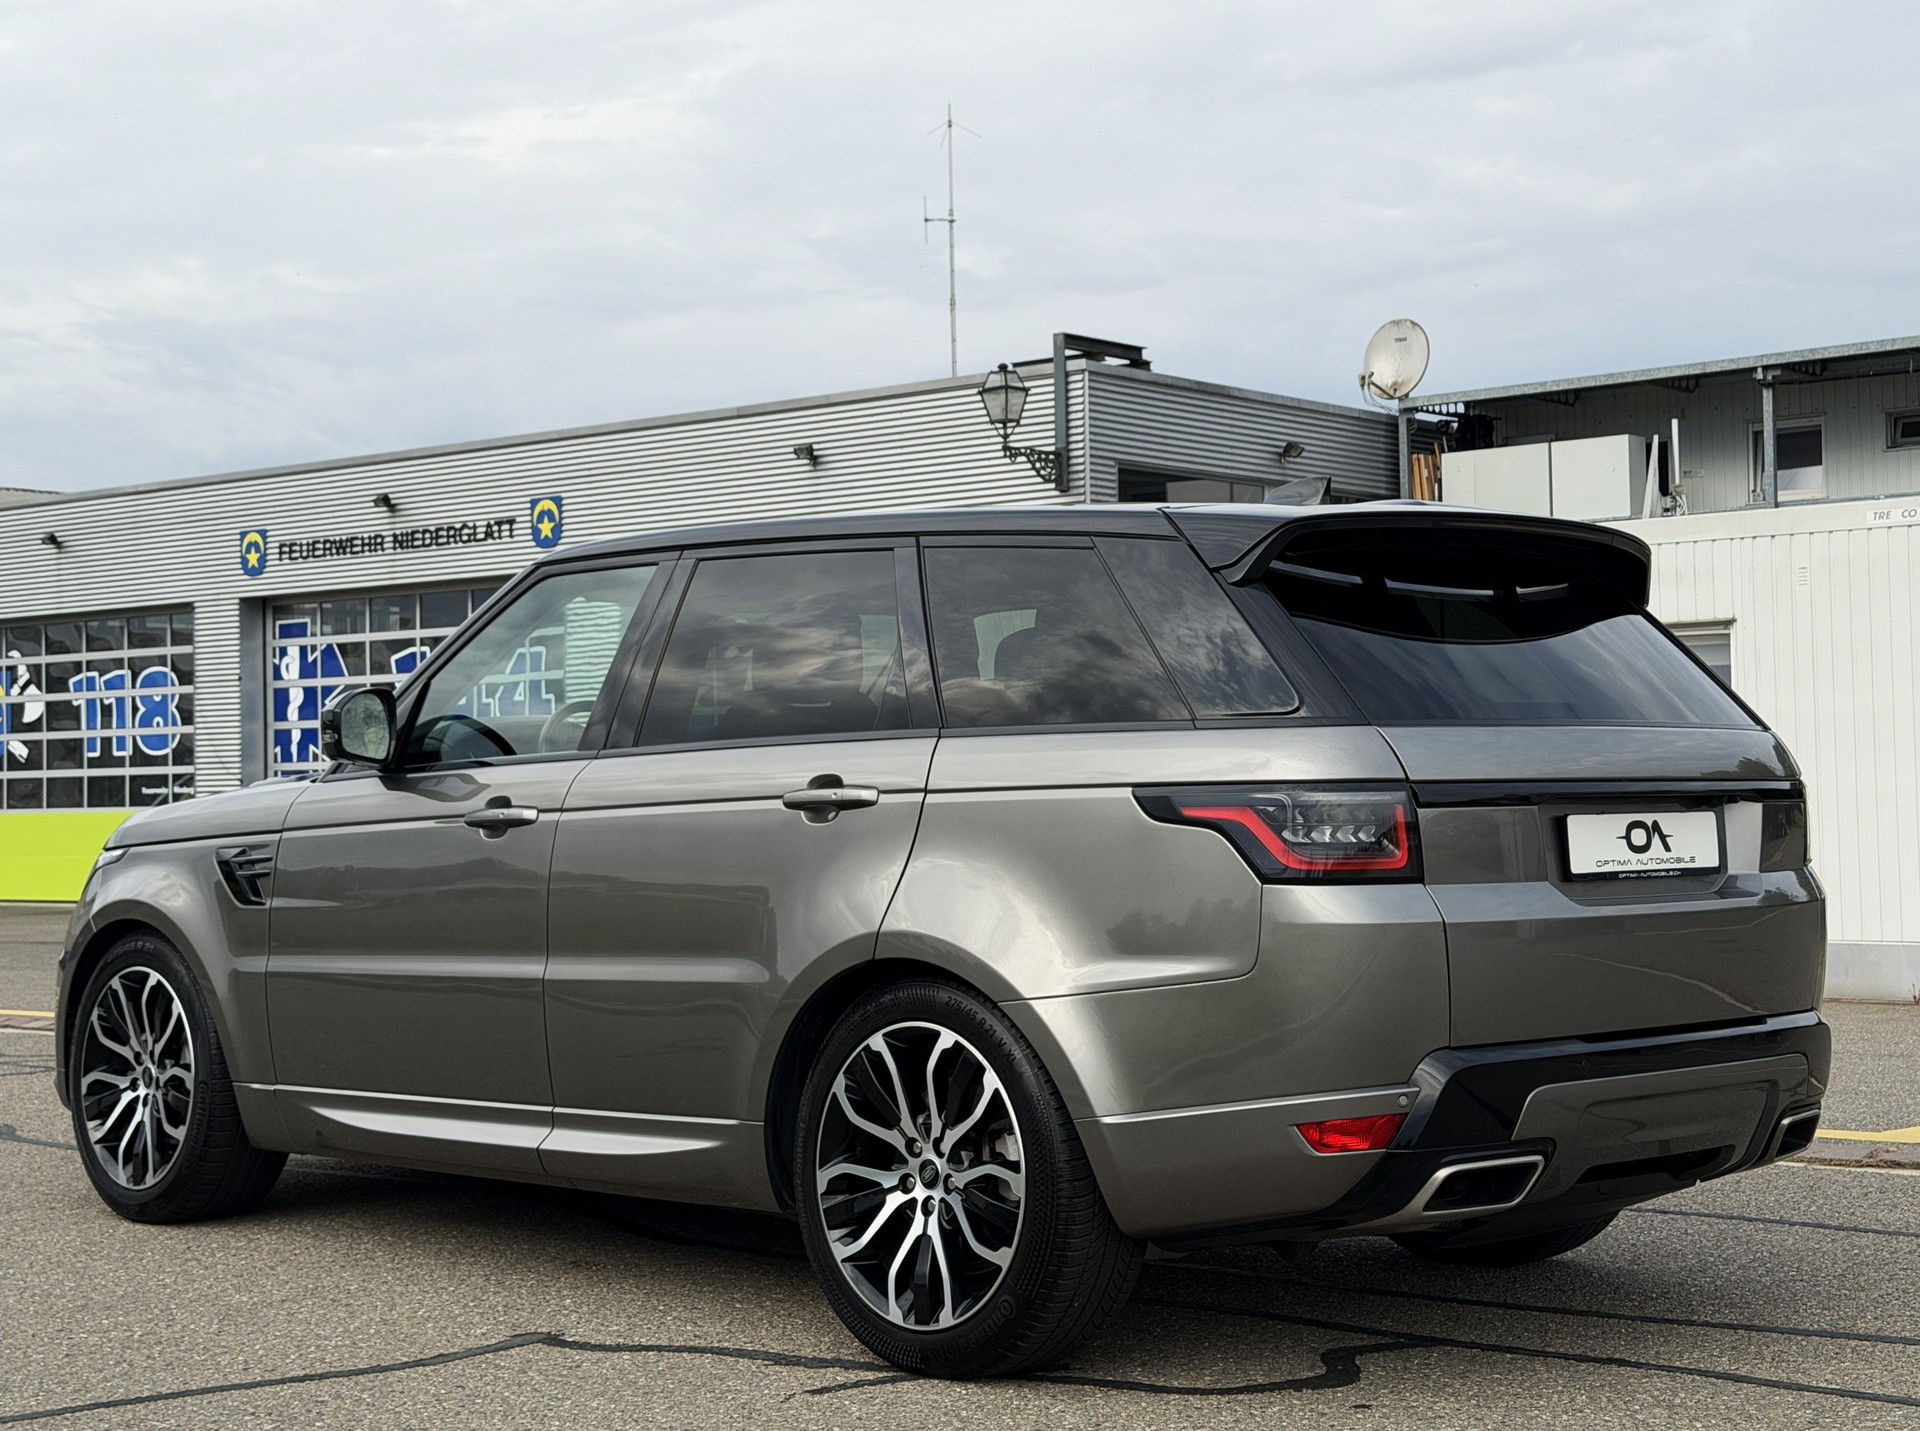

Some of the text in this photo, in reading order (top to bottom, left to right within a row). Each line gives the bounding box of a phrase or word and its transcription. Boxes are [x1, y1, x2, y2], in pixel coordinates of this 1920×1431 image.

[1873, 508, 1918, 521] TRE CO
[278, 518, 516, 562] FEUERWEHR NIEDERGLATT
[69, 666, 181, 758] 118
[1595, 856, 1697, 868] OPTIMA AUTOMOBILE
[943, 996, 979, 1021] 275/45
